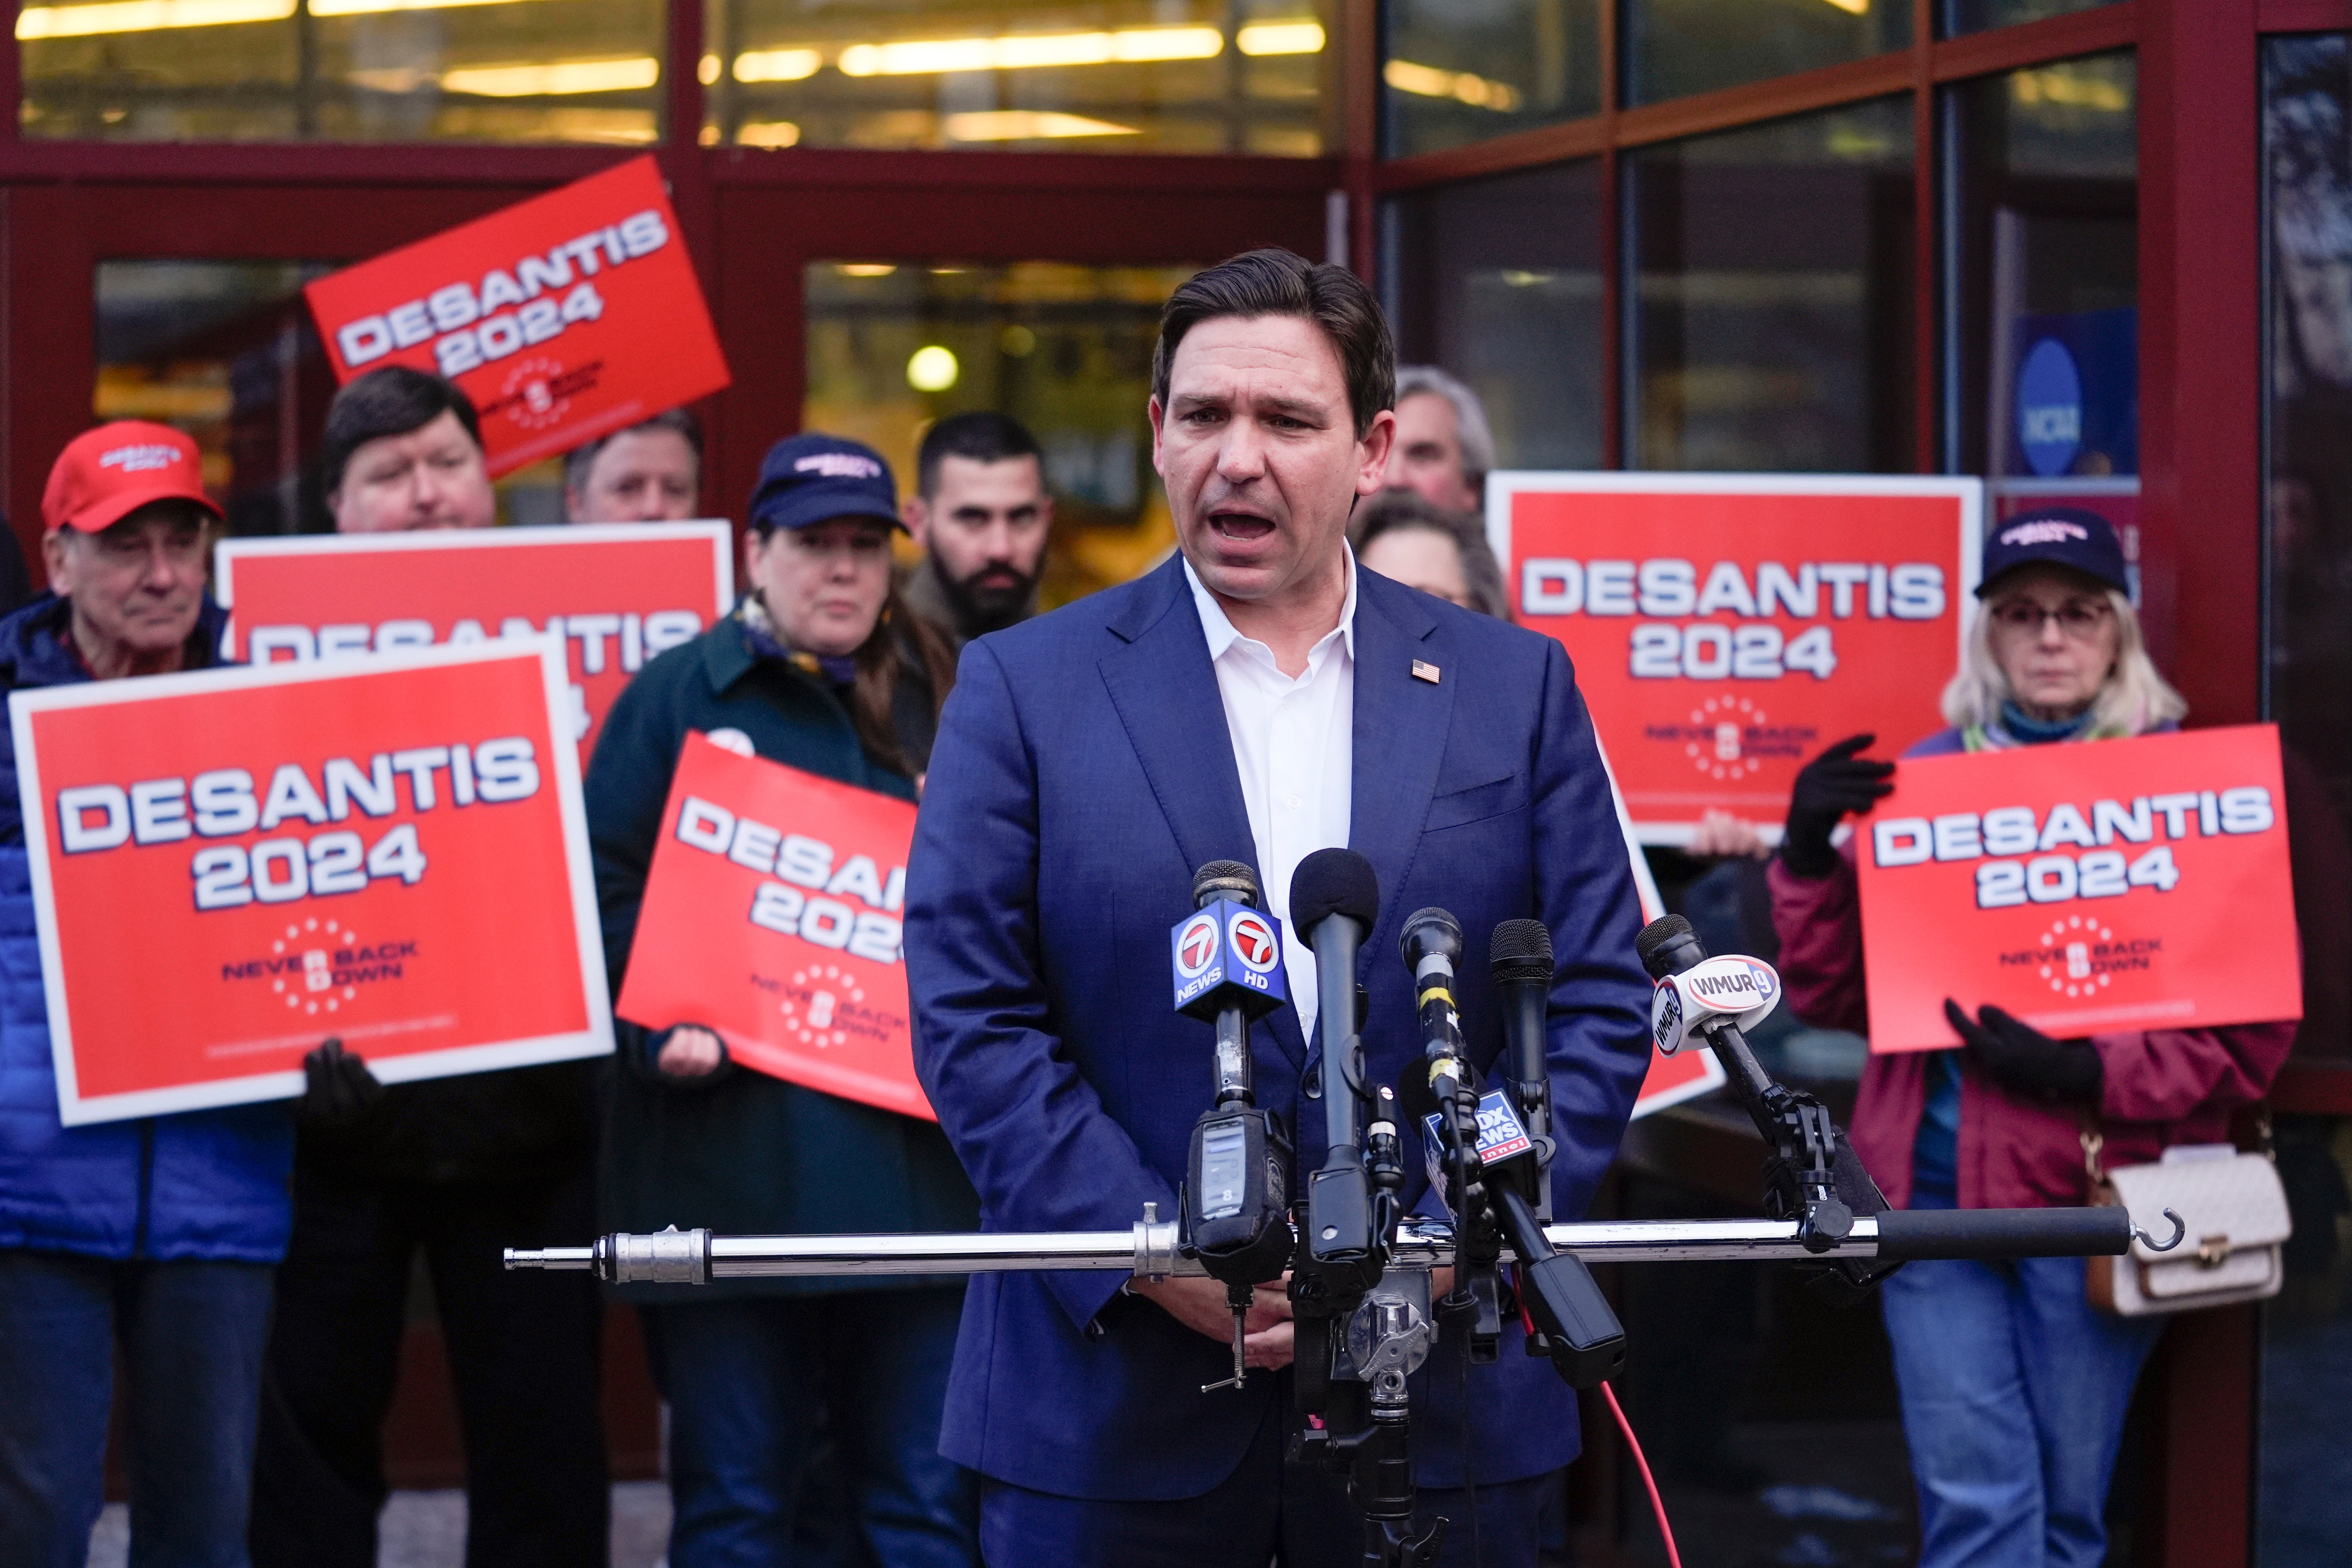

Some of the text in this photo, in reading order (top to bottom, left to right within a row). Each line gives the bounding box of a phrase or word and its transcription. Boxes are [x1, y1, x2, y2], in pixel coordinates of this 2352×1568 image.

[337, 209, 668, 367] DESANTIS
[434, 282, 604, 378] 2024
[1521, 558, 1946, 620] DESANTIS
[1629, 623, 1837, 680] 2024
[57, 736, 541, 854] DESANTIS
[675, 795, 907, 912] DESA
[1873, 786, 2275, 868] DESANTIS
[191, 822, 427, 911] 2024
[1975, 844, 2179, 910] 2024
[749, 880, 905, 965] 202
[1183, 925, 1213, 968] 7
[1236, 924, 1272, 964] 7
[335, 940, 418, 965] BACK
[1244, 970, 1268, 990] HD
[1177, 967, 1222, 1003] NEWS
[1475, 1106, 1511, 1130] OX
[1475, 1122, 1519, 1150] EWS
[1481, 1139, 1525, 1161] nnel
[1223, 1189, 1233, 1201] 8
